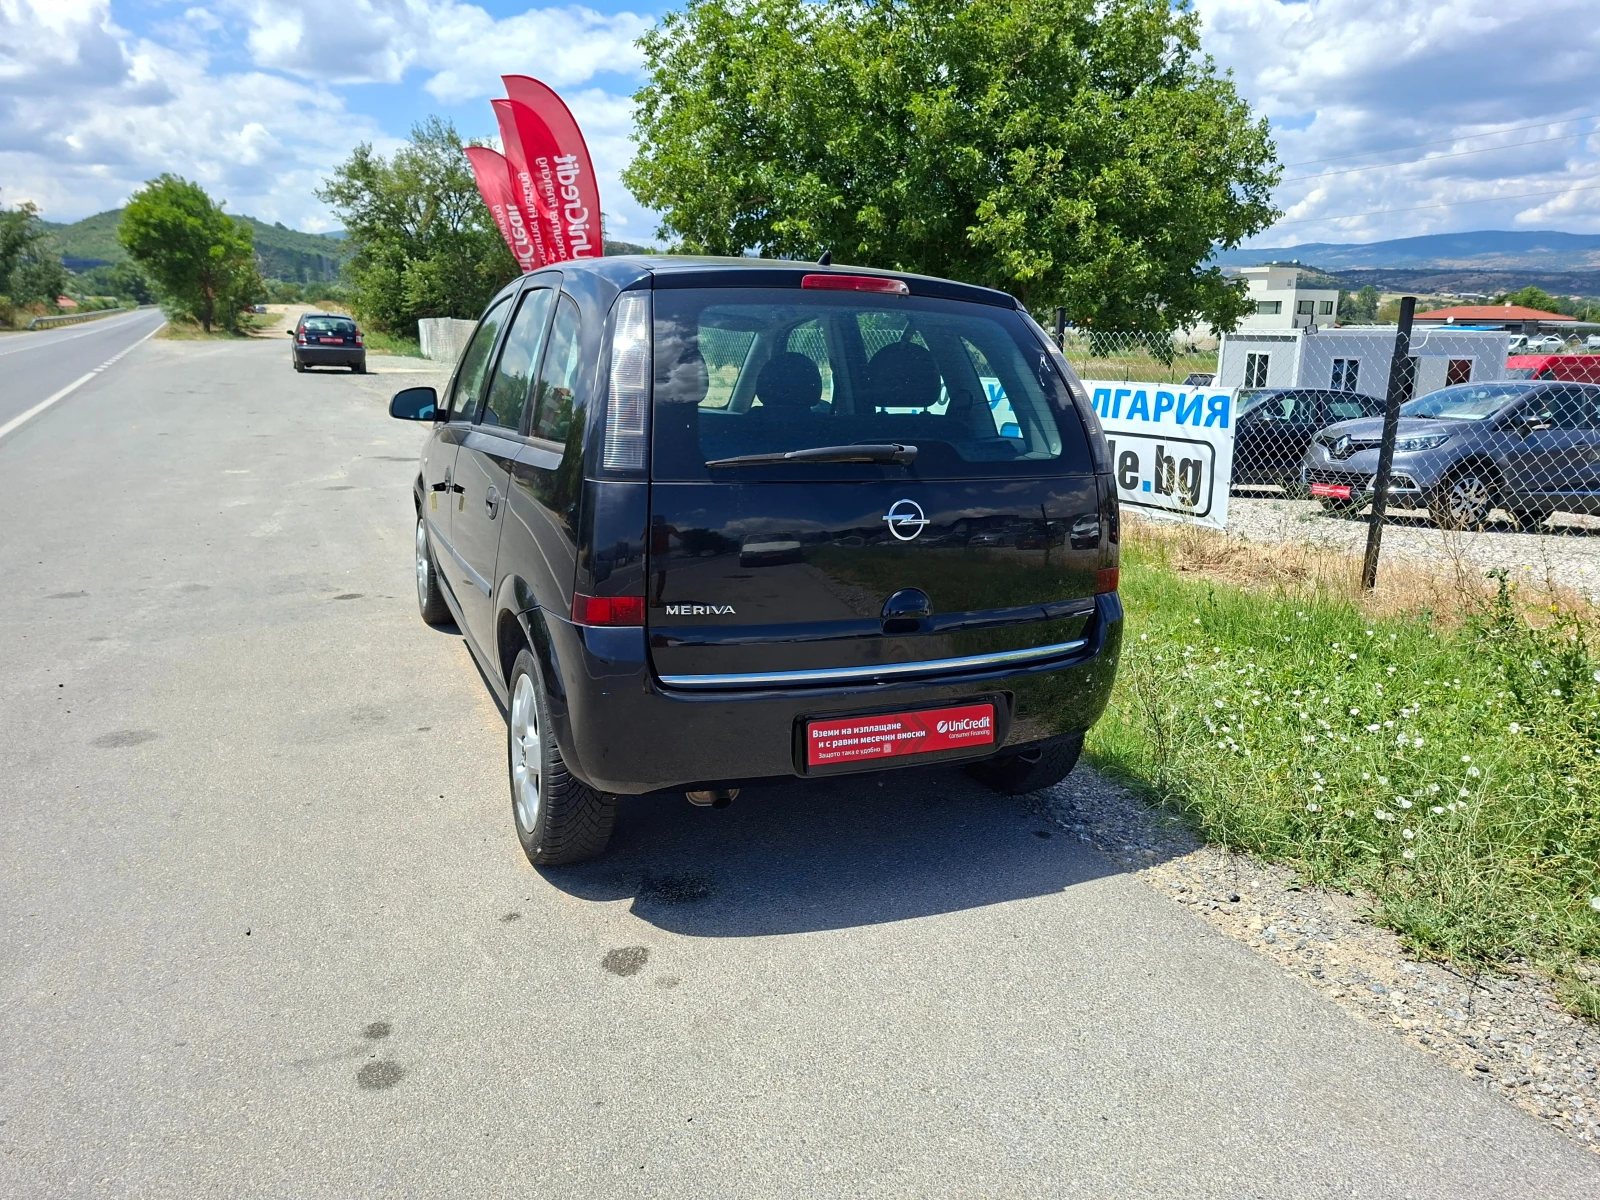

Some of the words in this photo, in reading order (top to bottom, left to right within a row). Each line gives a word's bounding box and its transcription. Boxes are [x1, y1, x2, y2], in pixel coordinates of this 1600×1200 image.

[665, 605, 736, 615] MERIVA
[812, 729, 839, 738] Вземи
[842, 727, 851, 735] на
[854, 722, 902, 734] изплащане
[948, 716, 990, 732] UniCredit
[832, 737, 859, 748] равни
[861, 734, 895, 744] месечни
[897, 731, 926, 739] вноски
